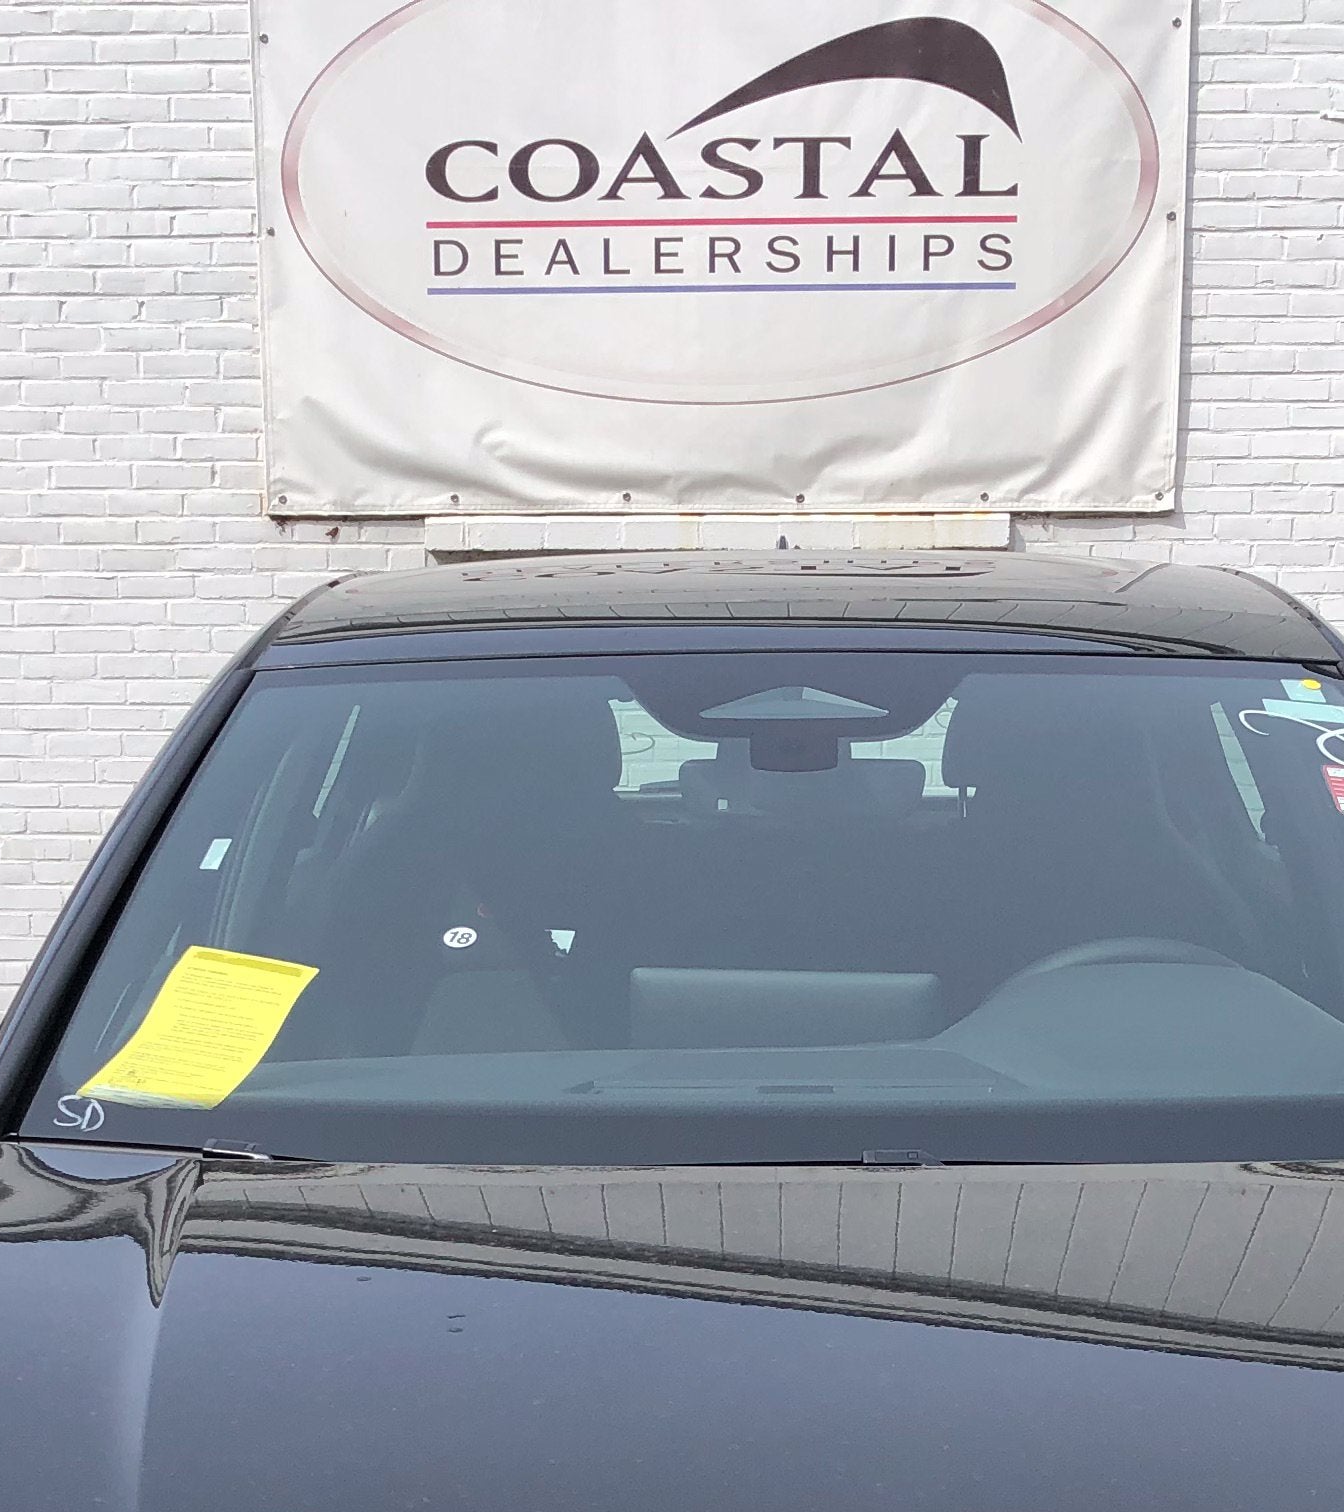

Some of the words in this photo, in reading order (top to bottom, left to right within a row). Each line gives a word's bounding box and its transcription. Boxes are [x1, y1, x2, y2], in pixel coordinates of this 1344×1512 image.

[425, 127, 1019, 204] COASTAL
[433, 232, 1015, 278] DEALERSHIPS
[448, 930, 473, 946] 18
